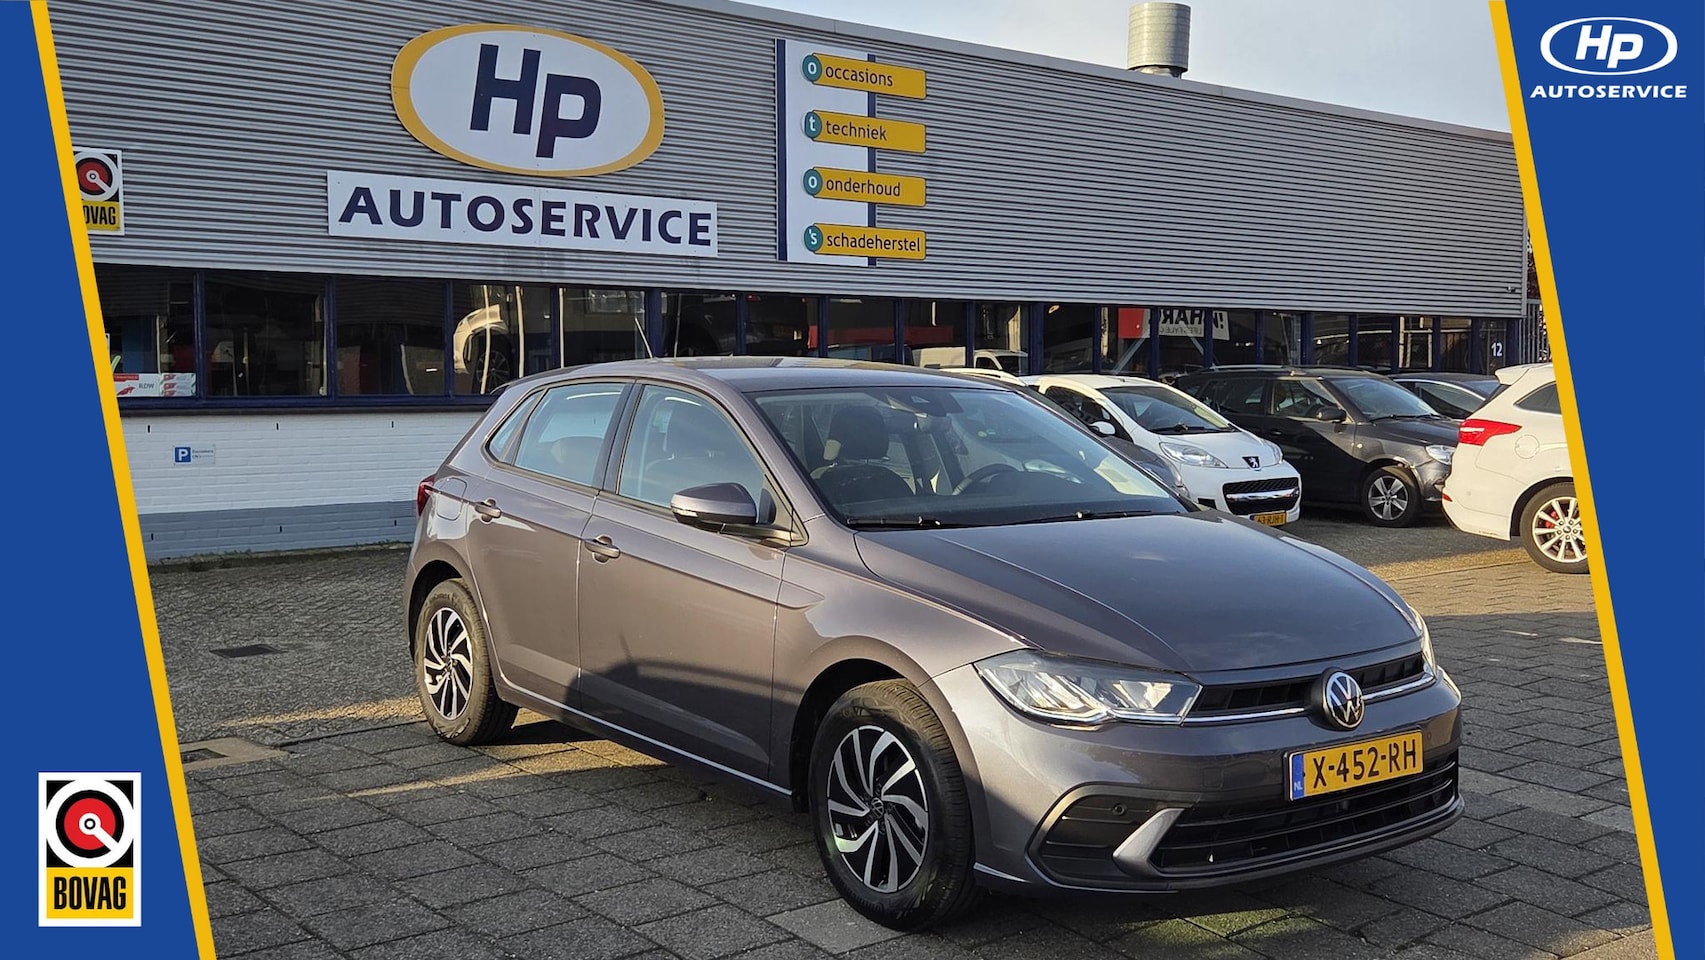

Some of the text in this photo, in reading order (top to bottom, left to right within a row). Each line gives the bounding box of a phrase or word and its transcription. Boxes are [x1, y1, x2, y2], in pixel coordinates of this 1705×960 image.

[825, 65, 893, 87] occasions
[809, 115, 888, 142] t techniek
[826, 177, 901, 197] onderhoud
[82, 205, 116, 225] OVAG
[338, 185, 712, 247] AUTOSERVICE
[826, 231, 921, 252] schadeherstel
[1491, 342, 1503, 357] 12
[1312, 738, 1417, 789] X-452-RH
